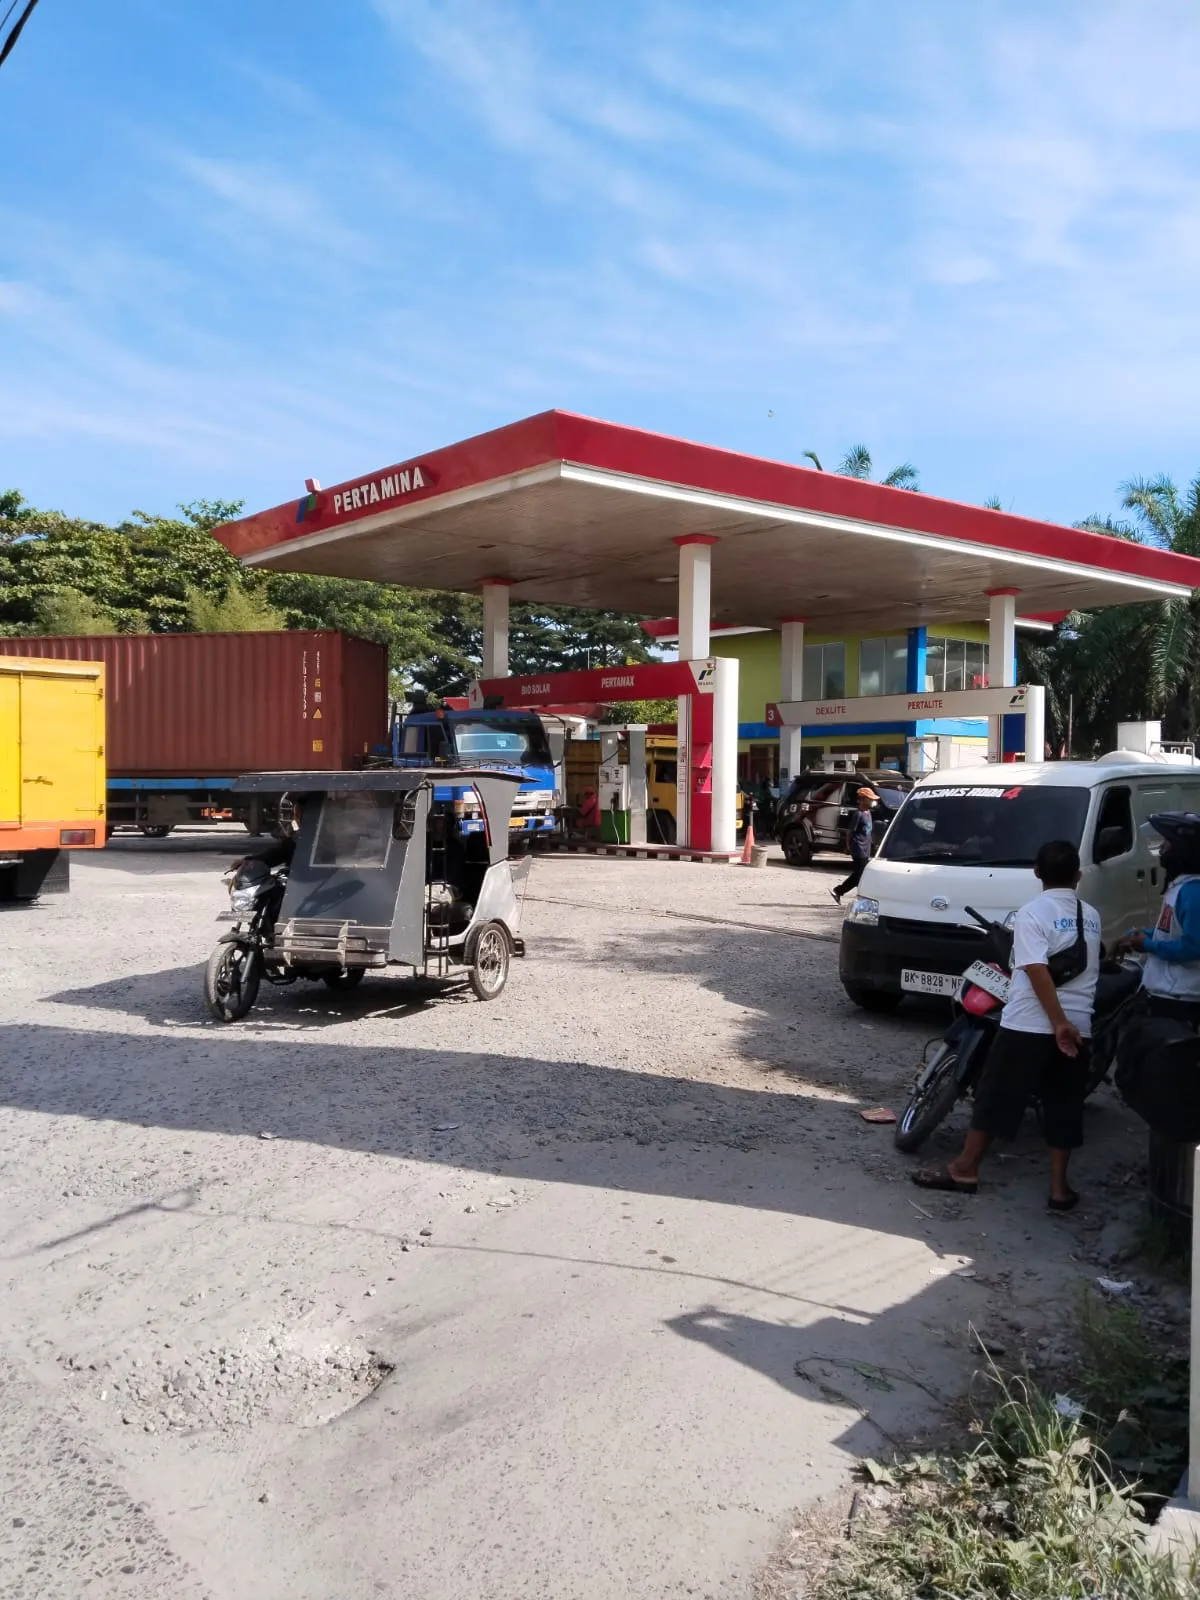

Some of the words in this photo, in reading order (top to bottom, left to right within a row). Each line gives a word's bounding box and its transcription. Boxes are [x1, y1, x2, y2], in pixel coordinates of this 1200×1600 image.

[333, 466, 425, 515] PERTAMINA
[532, 683, 551, 694] SOLAR
[601, 675, 635, 689] PERTAMAX
[815, 705, 847, 715] DEXLITE
[907, 699, 944, 711] PERTALITE
[767, 709, 775, 721] 3
[1002, 786, 1024, 800] 4
[904, 971, 916, 984] BK
[920, 973, 945, 988] 8828
